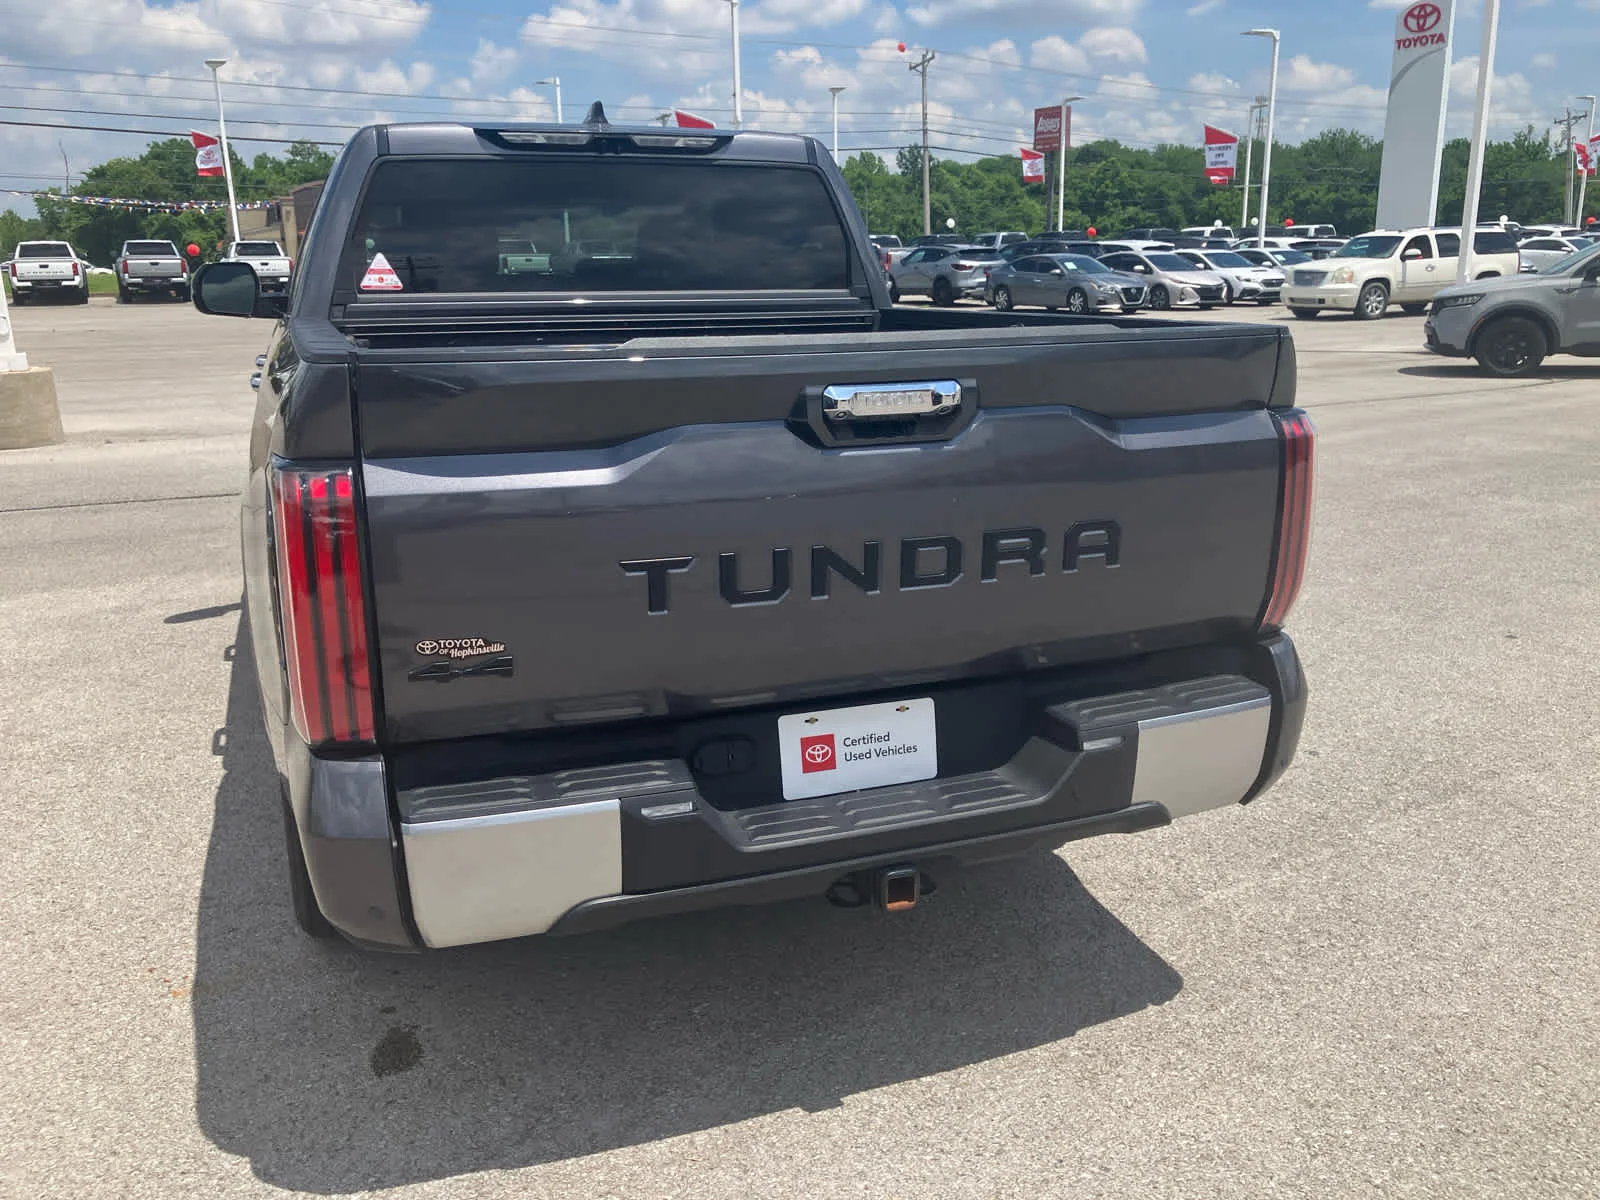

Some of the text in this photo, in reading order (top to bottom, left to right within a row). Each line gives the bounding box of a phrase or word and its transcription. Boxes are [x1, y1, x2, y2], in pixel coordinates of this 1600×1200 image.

[1396, 33, 1445, 50] TOYOTA
[617, 518, 1122, 616] TUNDRA
[439, 638, 485, 648] TOYOTA
[449, 643, 505, 658] Hopkinsville
[843, 731, 890, 747] Certified
[844, 743, 918, 762] Used Vehicles
